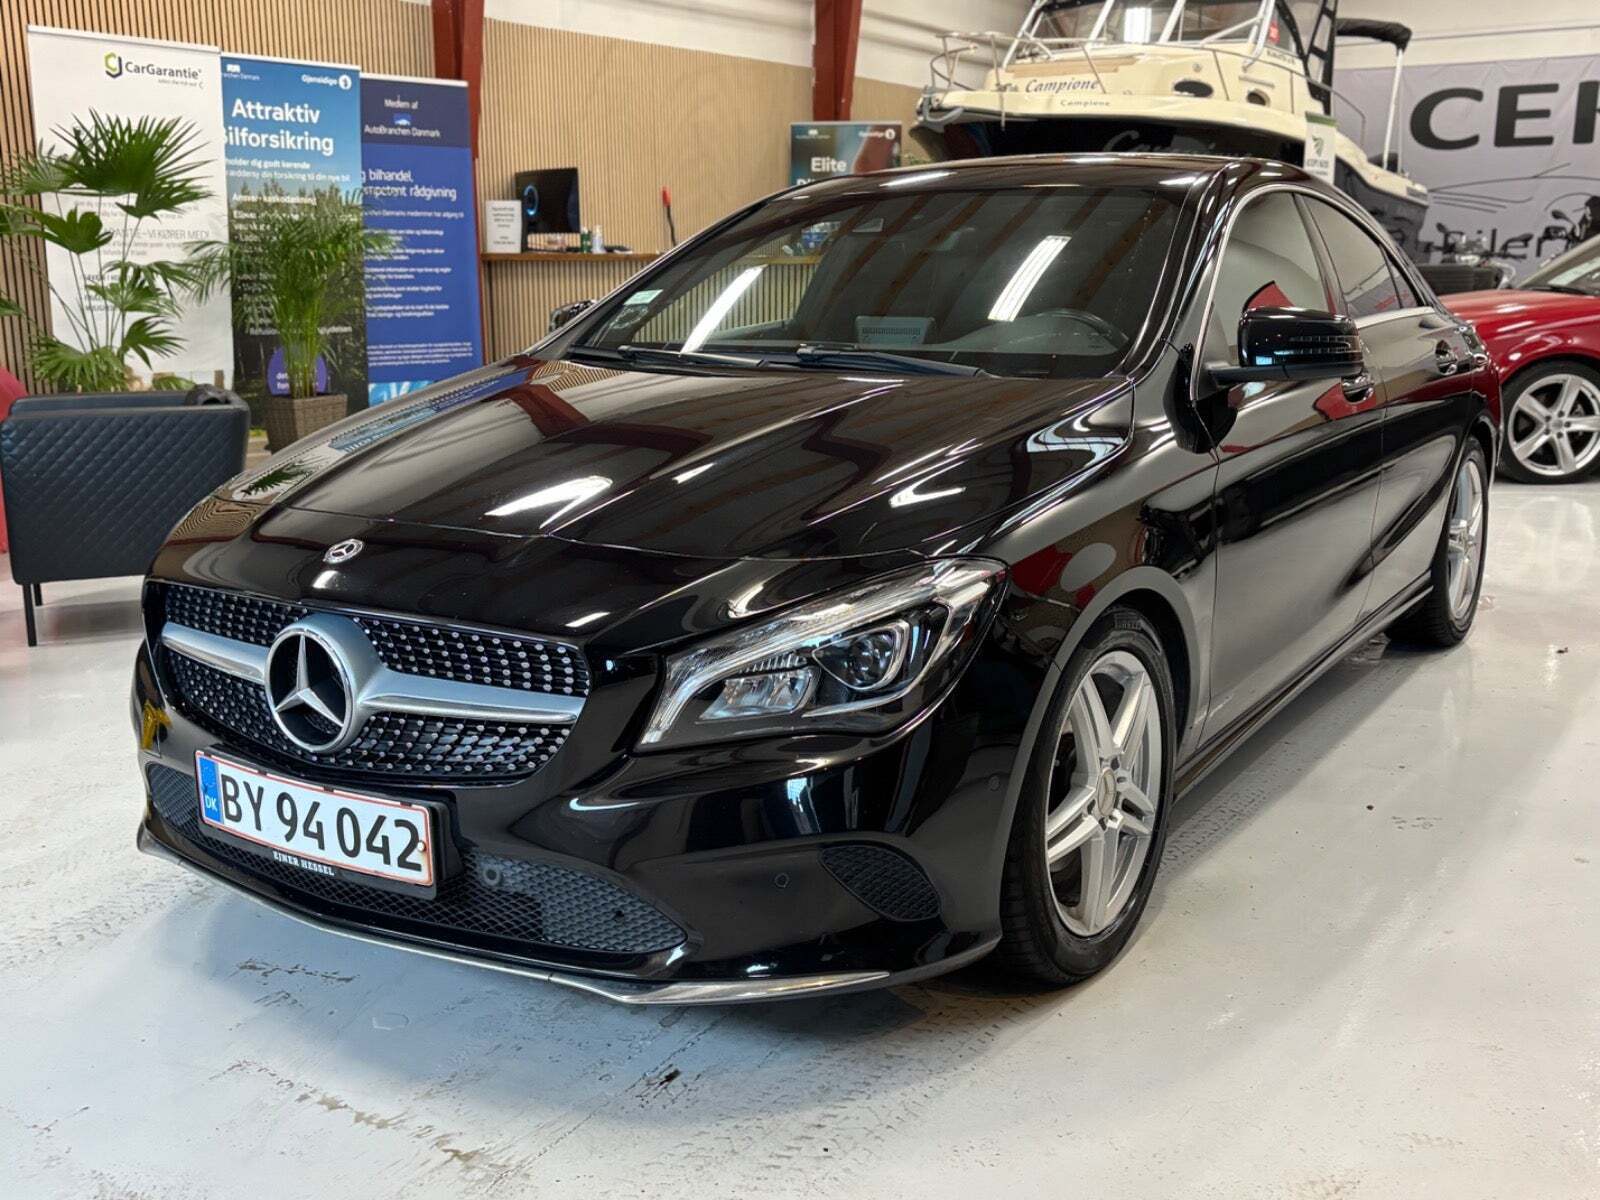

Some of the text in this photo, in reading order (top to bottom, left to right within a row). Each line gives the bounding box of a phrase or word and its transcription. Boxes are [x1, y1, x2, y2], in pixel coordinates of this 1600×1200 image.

[1025, 78, 1100, 94] Campione
[232, 98, 321, 124] Attraktiv
[364, 125, 441, 138] AutoBranchen Danmark
[811, 157, 848, 173] Elite
[409, 184, 457, 202] rådgivning
[204, 794, 219, 813] DK
[221, 773, 423, 873] BY 94 042
